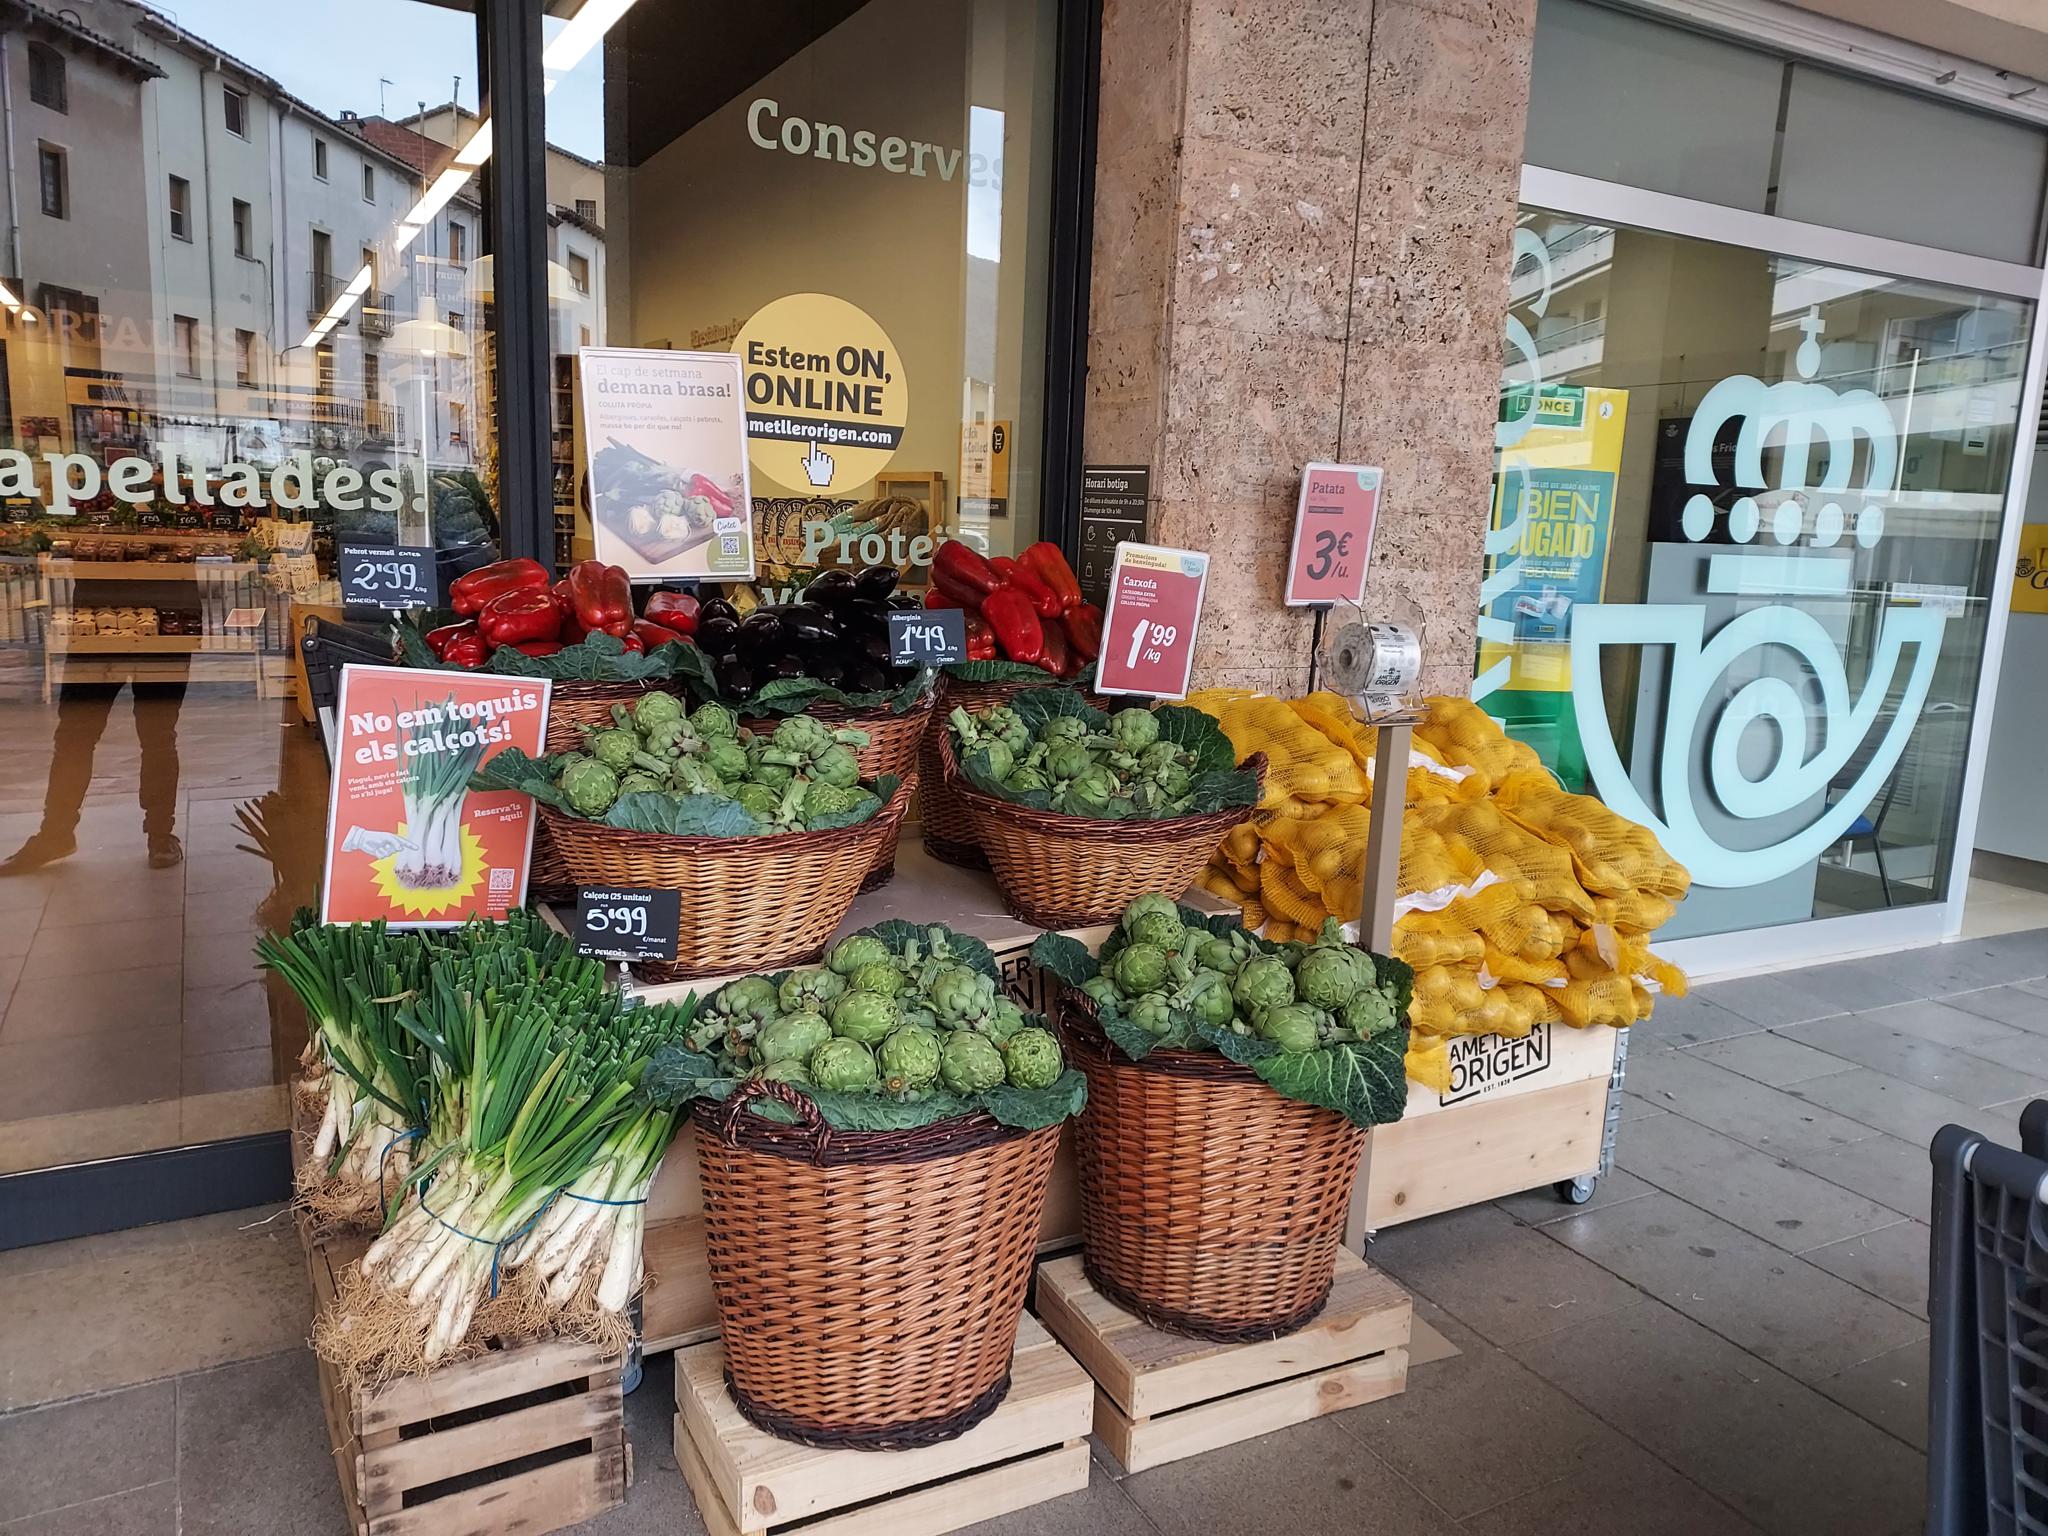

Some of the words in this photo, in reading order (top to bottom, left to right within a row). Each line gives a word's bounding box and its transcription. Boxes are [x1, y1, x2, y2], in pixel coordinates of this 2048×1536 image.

[596, 364, 607, 375] El
[610, 367, 632, 378] cap
[634, 366, 649, 377] de
[652, 368, 702, 379] setmana
[748, 341, 830, 373] Estem
[836, 345, 892, 384] ON,
[598, 378, 673, 395] demana
[677, 381, 731, 398] brasa!
[747, 372, 883, 416] ONLINE
[747, 419, 892, 445] metllerorigen.com
[1085, 478, 1106, 488] Horari
[1107, 478, 1128, 491] botiga
[1312, 482, 1345, 494] Patata
[344, 547, 368, 555] Pebrot
[352, 563, 417, 590] 2'99
[1123, 576, 1157, 589] Carxofa
[899, 625, 946, 655] 1'49
[1143, 648, 1161, 664] /kg
[349, 712, 392, 736] No
[397, 707, 444, 729] em
[446, 688, 538, 722] toquis
[354, 740, 399, 765] els
[403, 719, 513, 756] calçots!
[348, 776, 374, 785] Plogui,
[374, 773, 389, 781] nevi
[396, 770, 410, 779] faci
[368, 781, 384, 789] amb
[396, 775, 420, 784] calçots
[361, 790, 374, 798] s'hi
[375, 787, 393, 797] juga!
[474, 803, 521, 818] Reserva'ls
[583, 891, 609, 900] Calçots
[622, 894, 652, 902] unitats)
[586, 907, 647, 936] 5'99
[1450, 1023, 1543, 1062] AMETLR
[1449, 1034, 1543, 1093] ORIGEN
